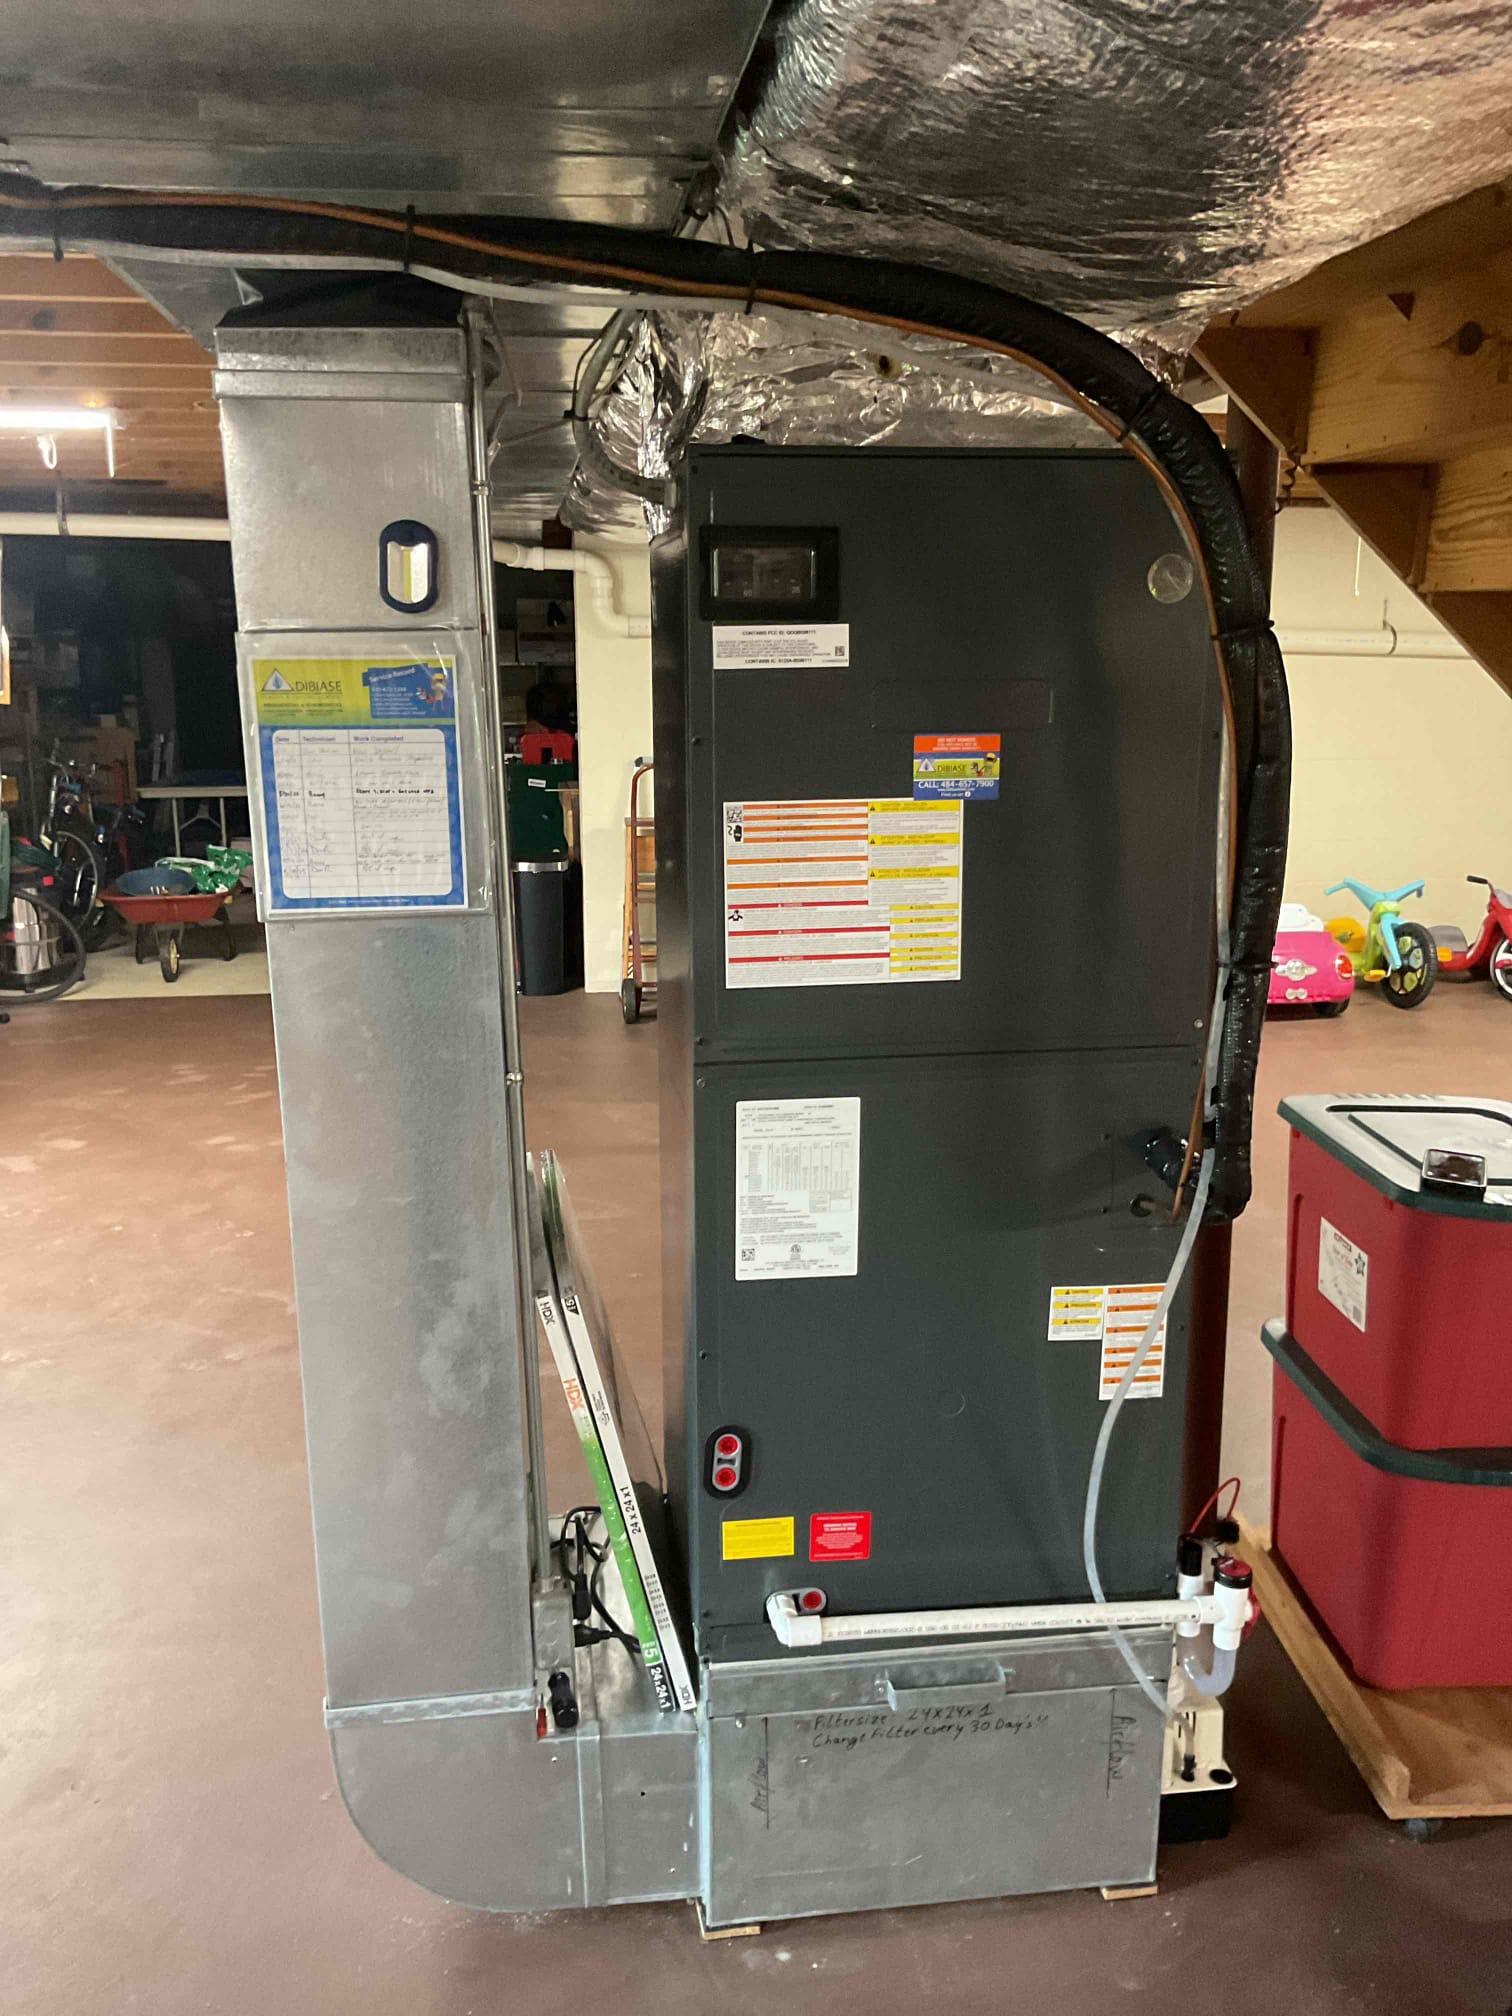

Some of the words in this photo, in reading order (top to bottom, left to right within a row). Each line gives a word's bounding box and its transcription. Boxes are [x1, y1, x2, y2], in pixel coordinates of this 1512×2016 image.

[295, 681, 342, 692] DIBIASE
[539, 1301, 556, 1326] HDX
[563, 1378, 585, 1410] HDX
[625, 1500, 635, 1513] 24
[632, 1523, 641, 1535] 24
[645, 1648, 658, 1658] 5
[650, 1667, 671, 1711] 24x24x1
[812, 1733, 866, 1750] Change
[924, 1724, 963, 1741] every
[972, 1720, 990, 1733] 30
